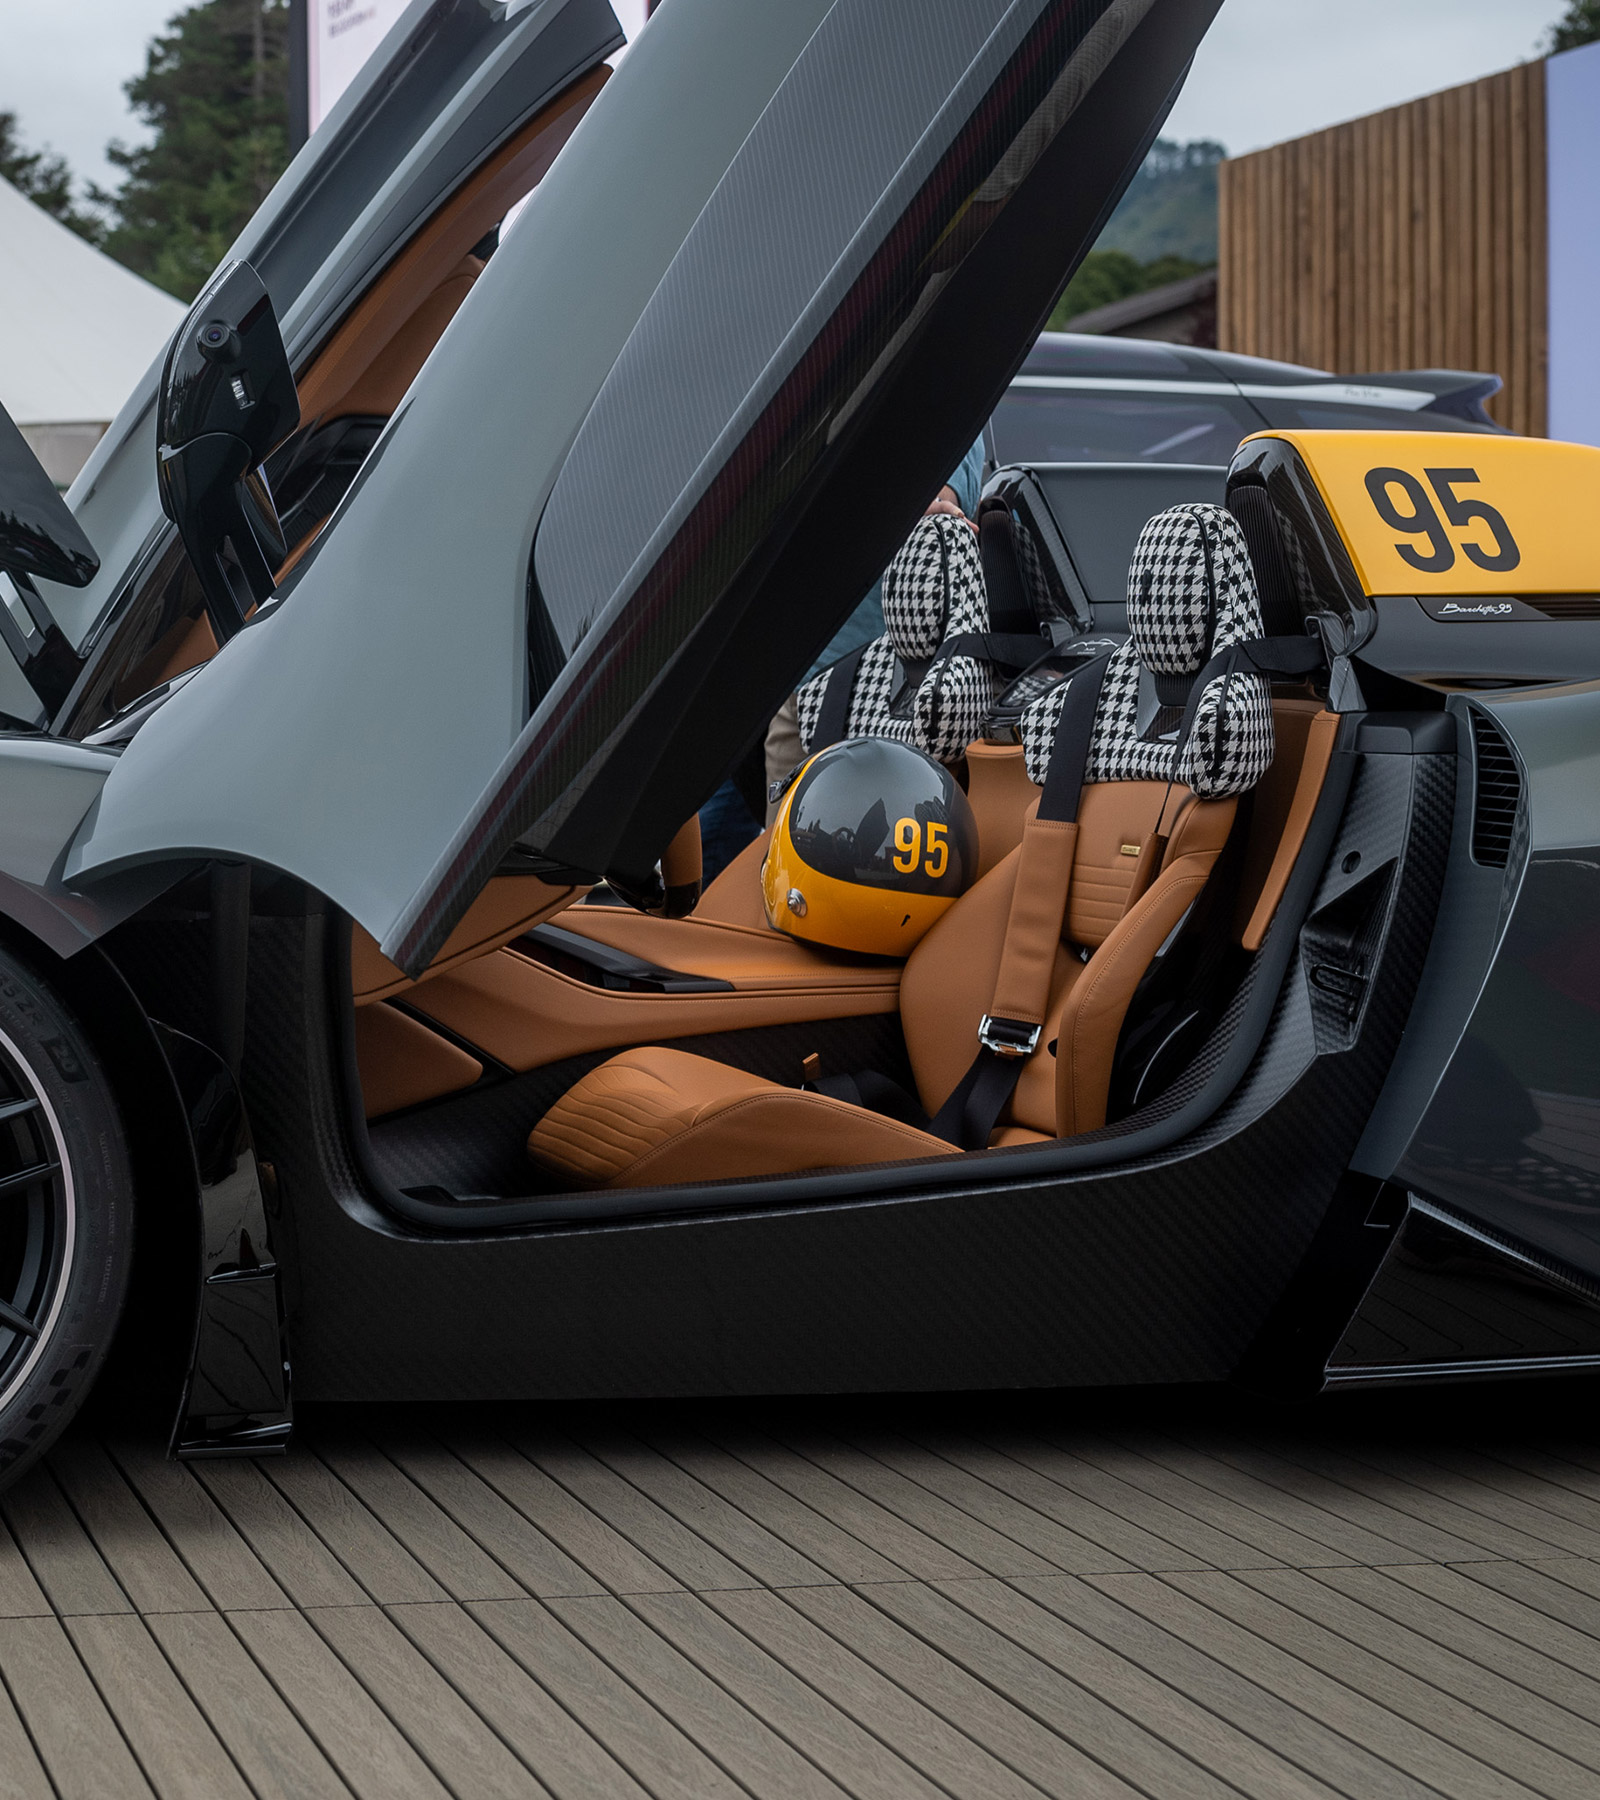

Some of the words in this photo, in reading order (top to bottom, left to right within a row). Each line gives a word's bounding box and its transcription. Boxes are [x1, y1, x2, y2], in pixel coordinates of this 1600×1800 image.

[1364, 467, 1521, 573] 95
[893, 817, 950, 878] 95
[52, 1042, 76, 1073] 20
